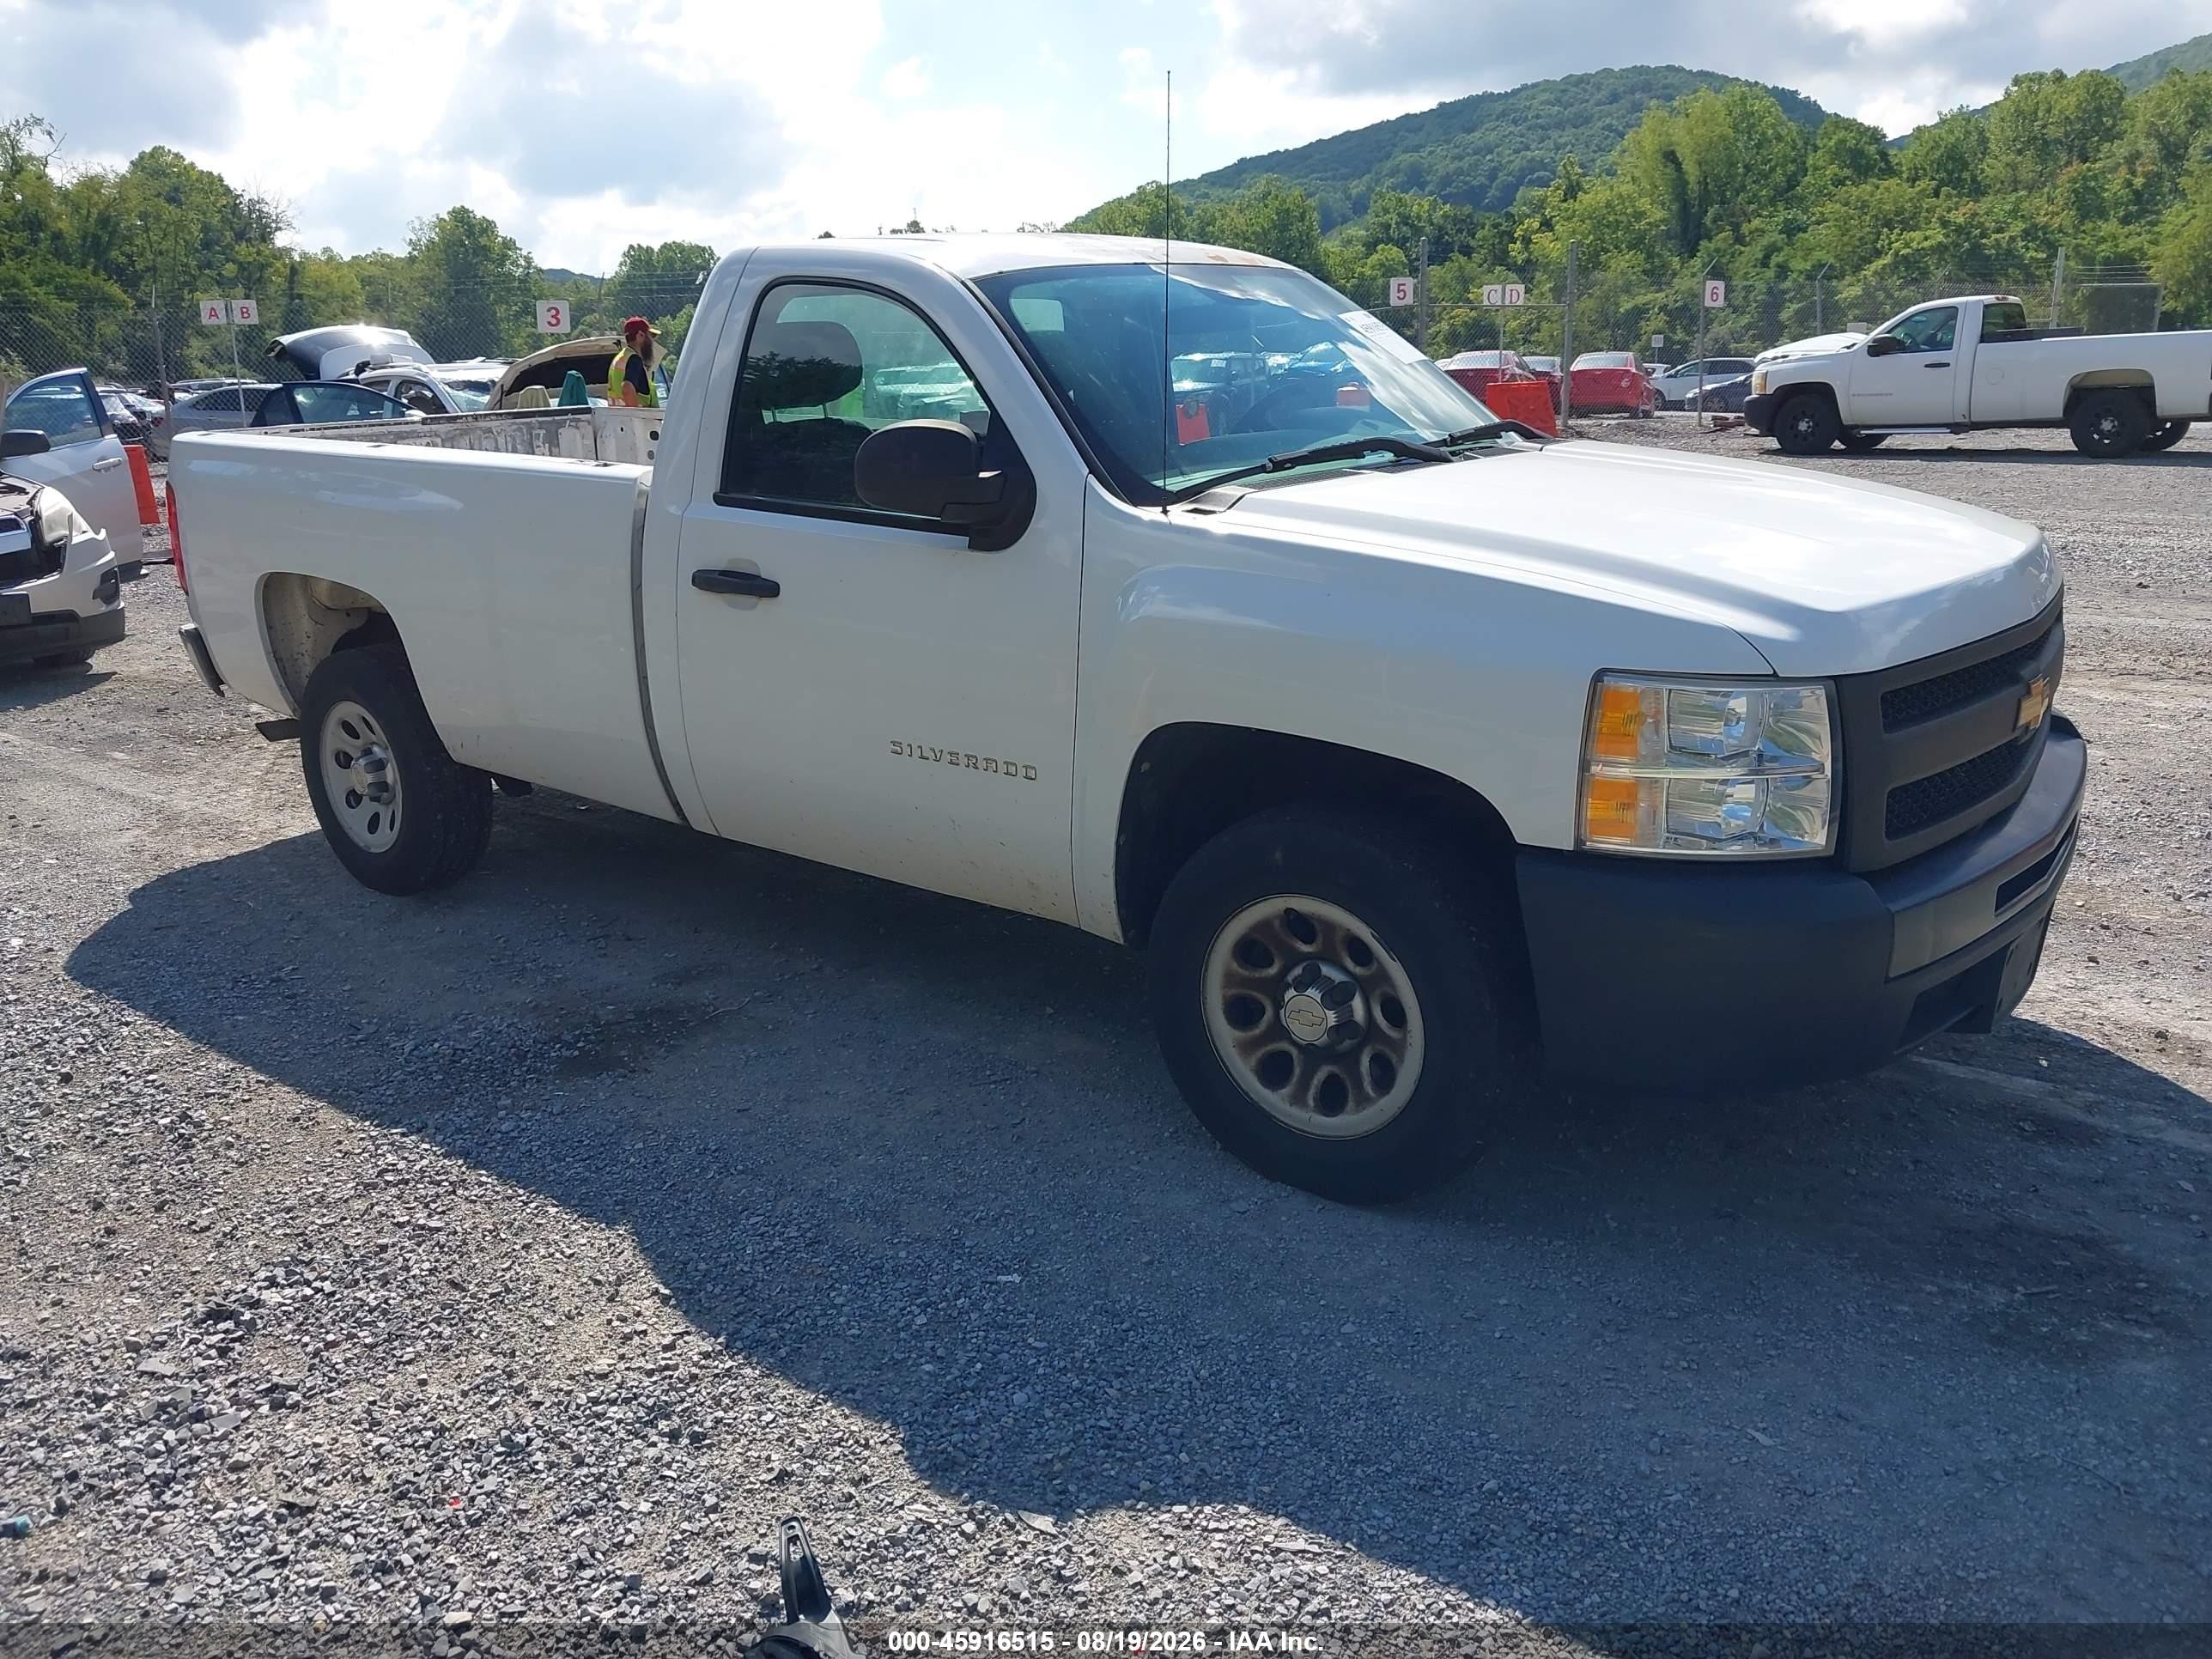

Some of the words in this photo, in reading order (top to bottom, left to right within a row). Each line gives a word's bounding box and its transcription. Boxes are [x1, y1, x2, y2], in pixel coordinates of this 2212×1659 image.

[1396, 283, 1407, 301] 5
[1487, 289, 1498, 305] C
[1509, 289, 1520, 304] D
[1711, 285, 1719, 302] 6
[208, 306, 220, 320] A
[240, 306, 251, 319] B
[546, 306, 562, 327] 3
[890, 739, 1037, 781] SILVERADO
